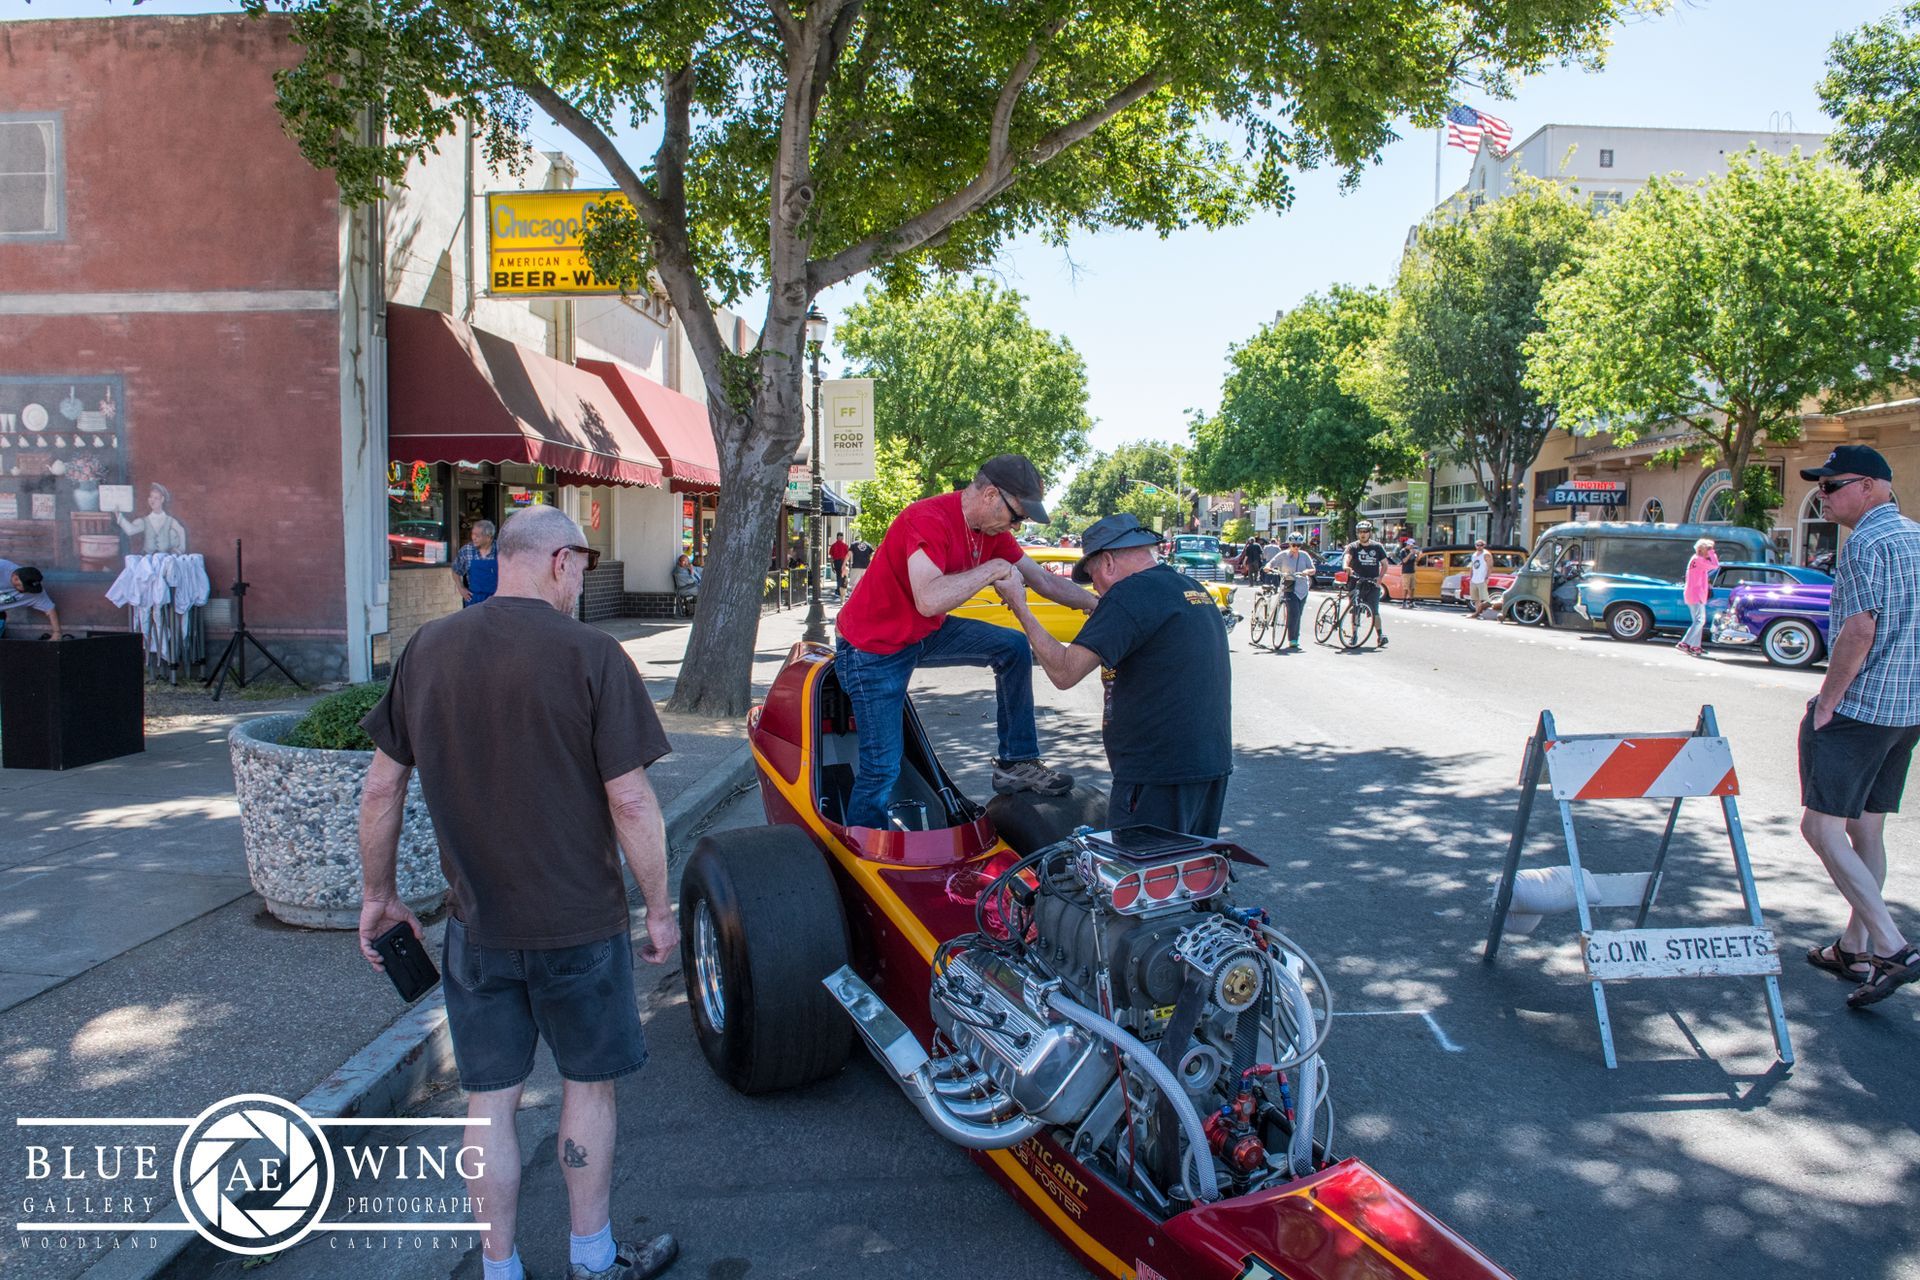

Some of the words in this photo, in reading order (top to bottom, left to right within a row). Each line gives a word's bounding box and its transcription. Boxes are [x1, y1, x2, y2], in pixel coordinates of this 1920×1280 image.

[493, 204, 578, 245] Chicago
[499, 257, 560, 267] AMERICAN
[840, 407, 856, 417] FF
[833, 433, 864, 441] FOOD
[833, 441, 864, 449] FRONT
[1555, 491, 1622, 504] BAKERY
[1666, 935, 1769, 960] STREETS
[1053, 1162, 1089, 1198] ART
[1034, 1163, 1081, 1220] FOSTER
